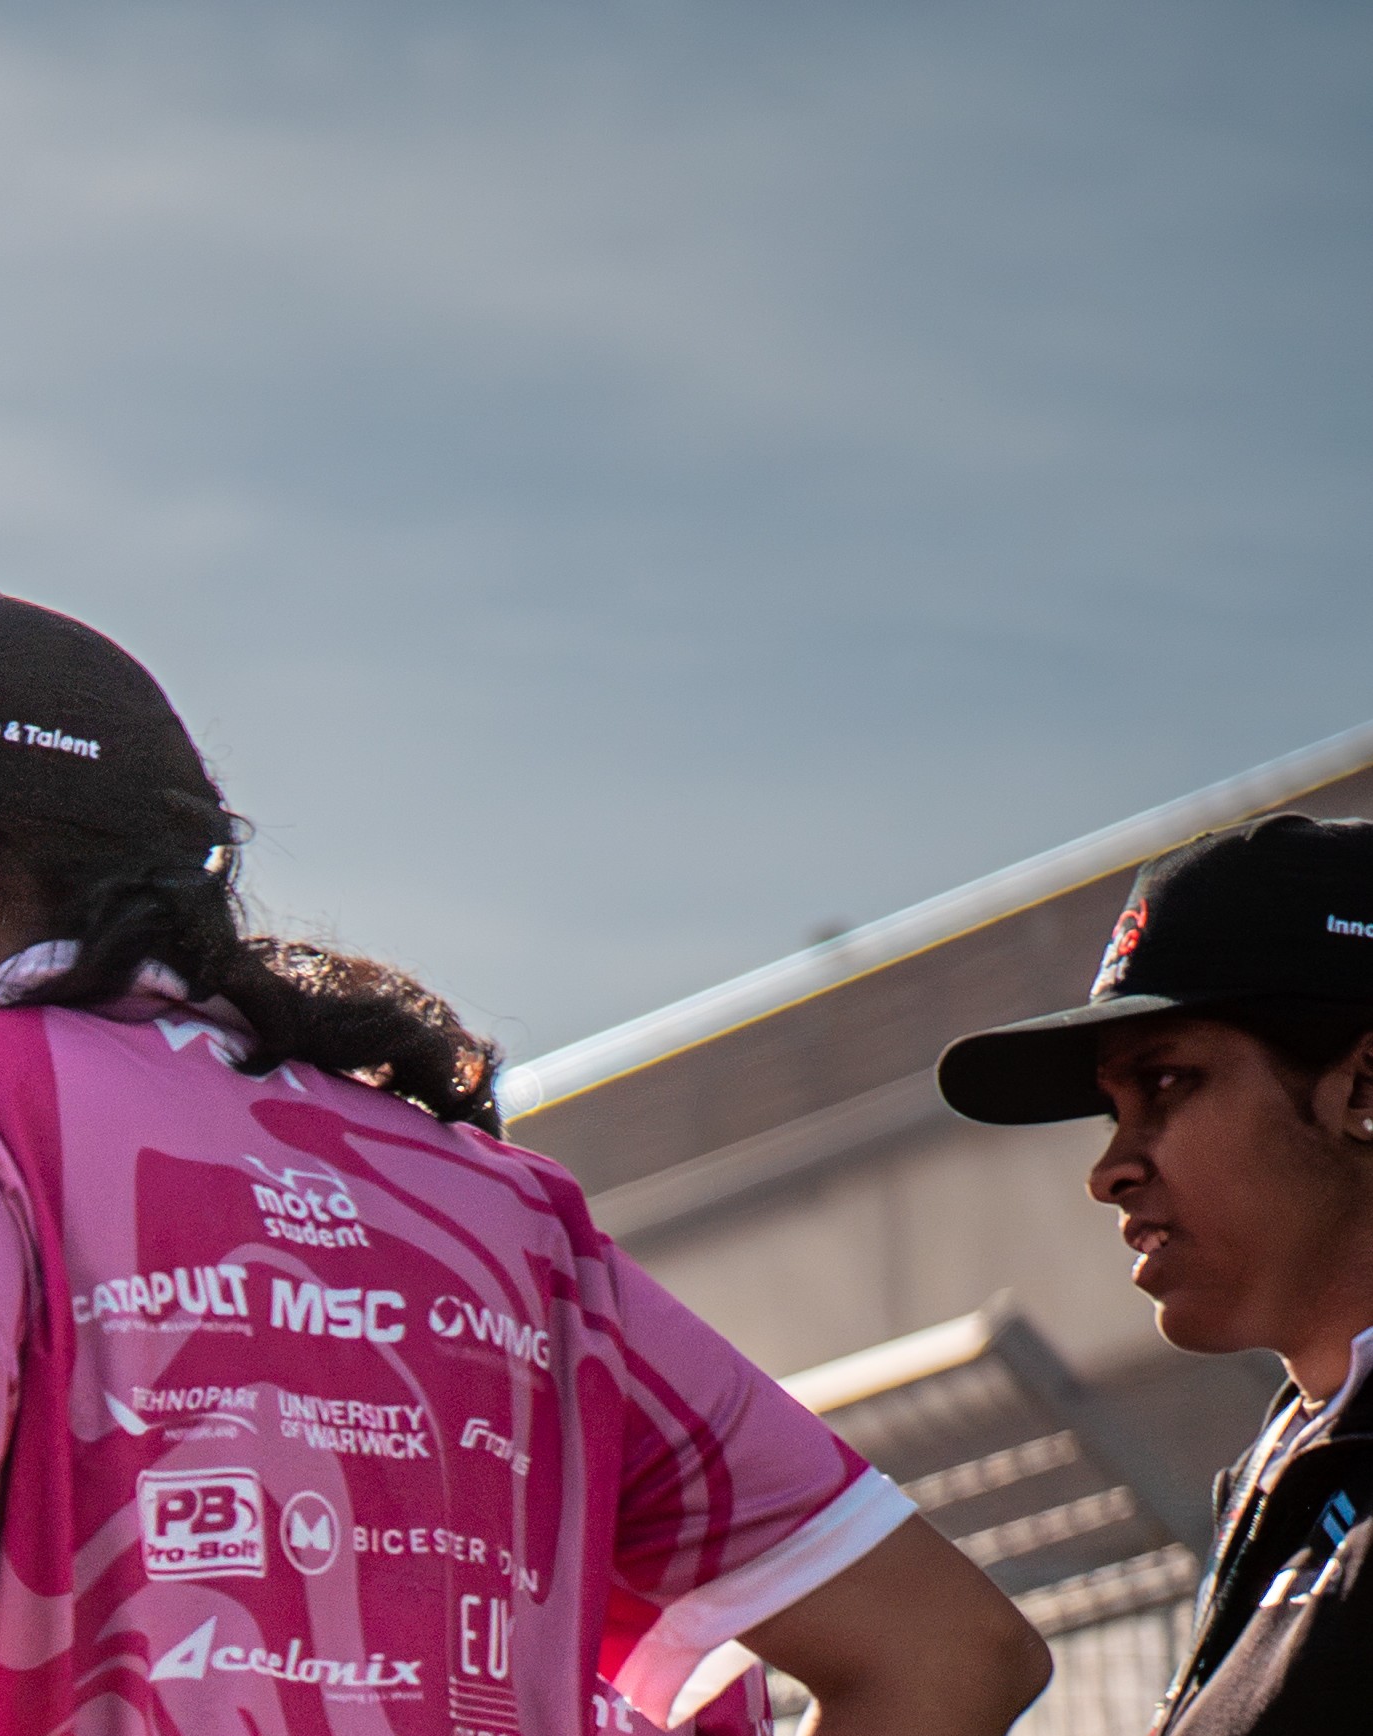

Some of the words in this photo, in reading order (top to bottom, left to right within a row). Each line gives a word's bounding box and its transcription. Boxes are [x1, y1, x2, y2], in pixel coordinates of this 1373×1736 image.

[4, 719, 21, 742] &
[23, 724, 101, 759] Talent
[251, 1184, 357, 1222] moto
[264, 1217, 370, 1248] student
[72, 1264, 248, 1322] CATAPULT
[270, 1277, 406, 1343] MSC
[462, 1302, 550, 1370] WMG
[278, 1390, 424, 1430] UNIVERSITY
[304, 1424, 430, 1460] WARWICK
[156, 1486, 237, 1537] PB
